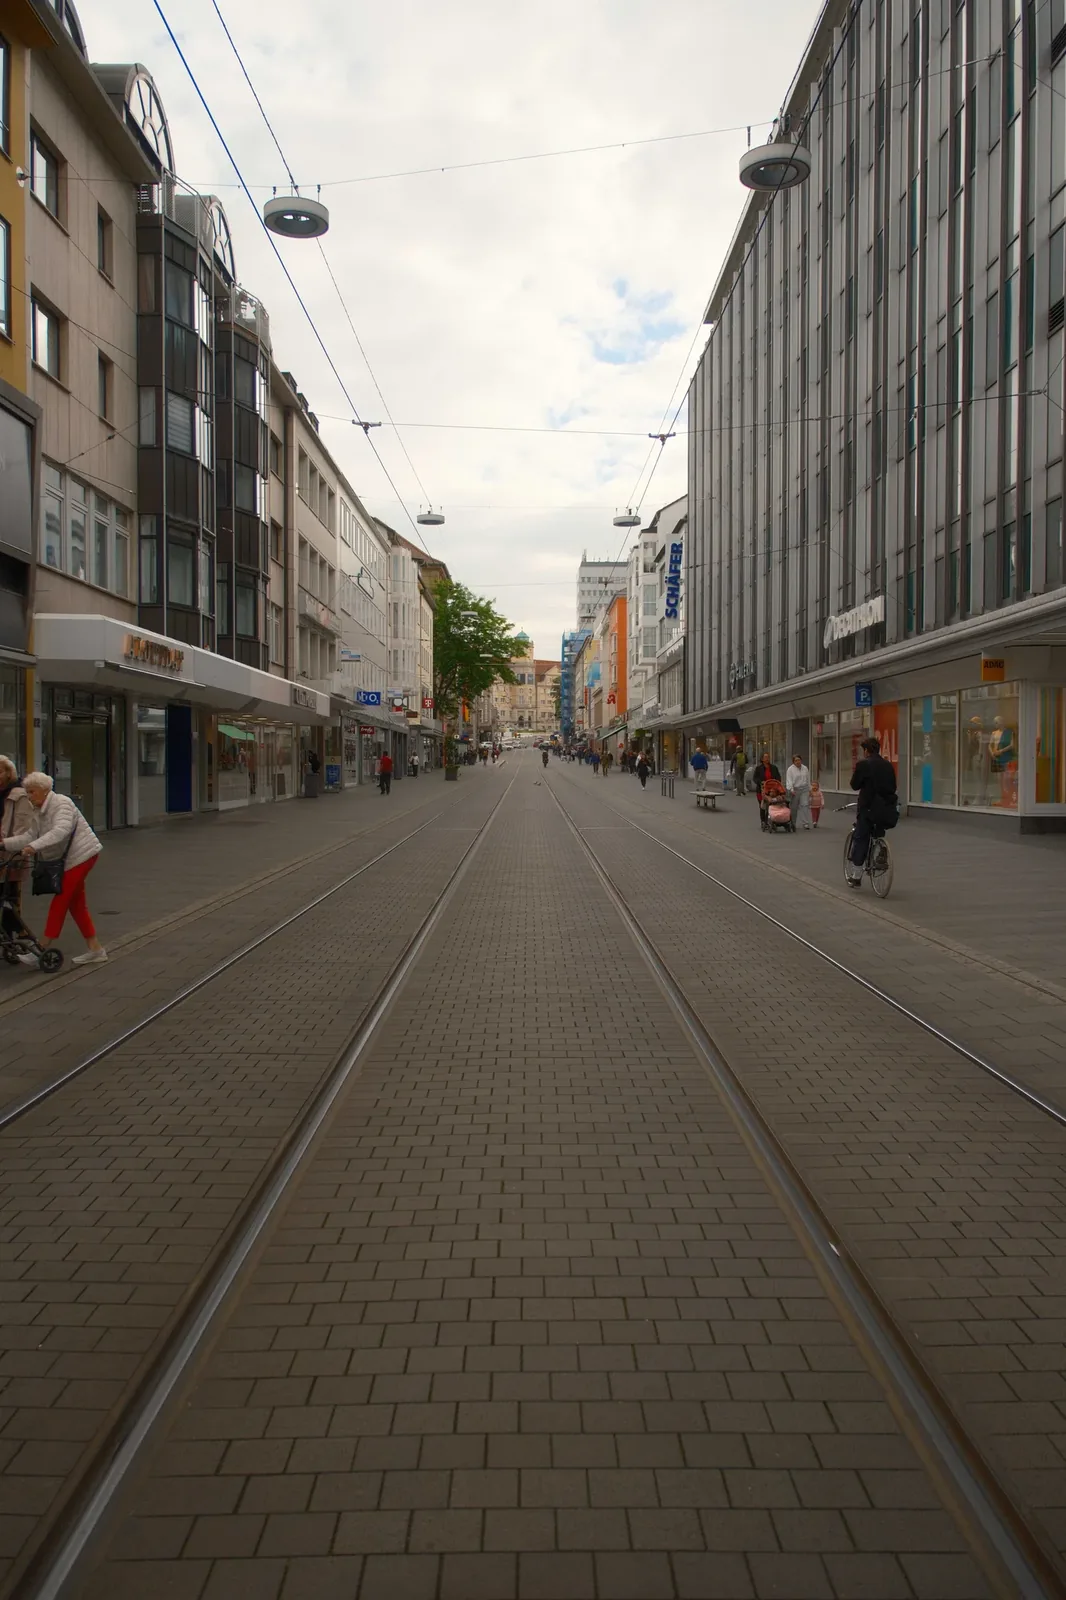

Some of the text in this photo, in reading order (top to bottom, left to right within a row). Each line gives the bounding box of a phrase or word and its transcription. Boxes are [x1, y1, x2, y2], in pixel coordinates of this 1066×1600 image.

[665, 543, 685, 620] SCHÄFER
[983, 660, 1005, 669] ADAC
[860, 691, 869, 702] P
